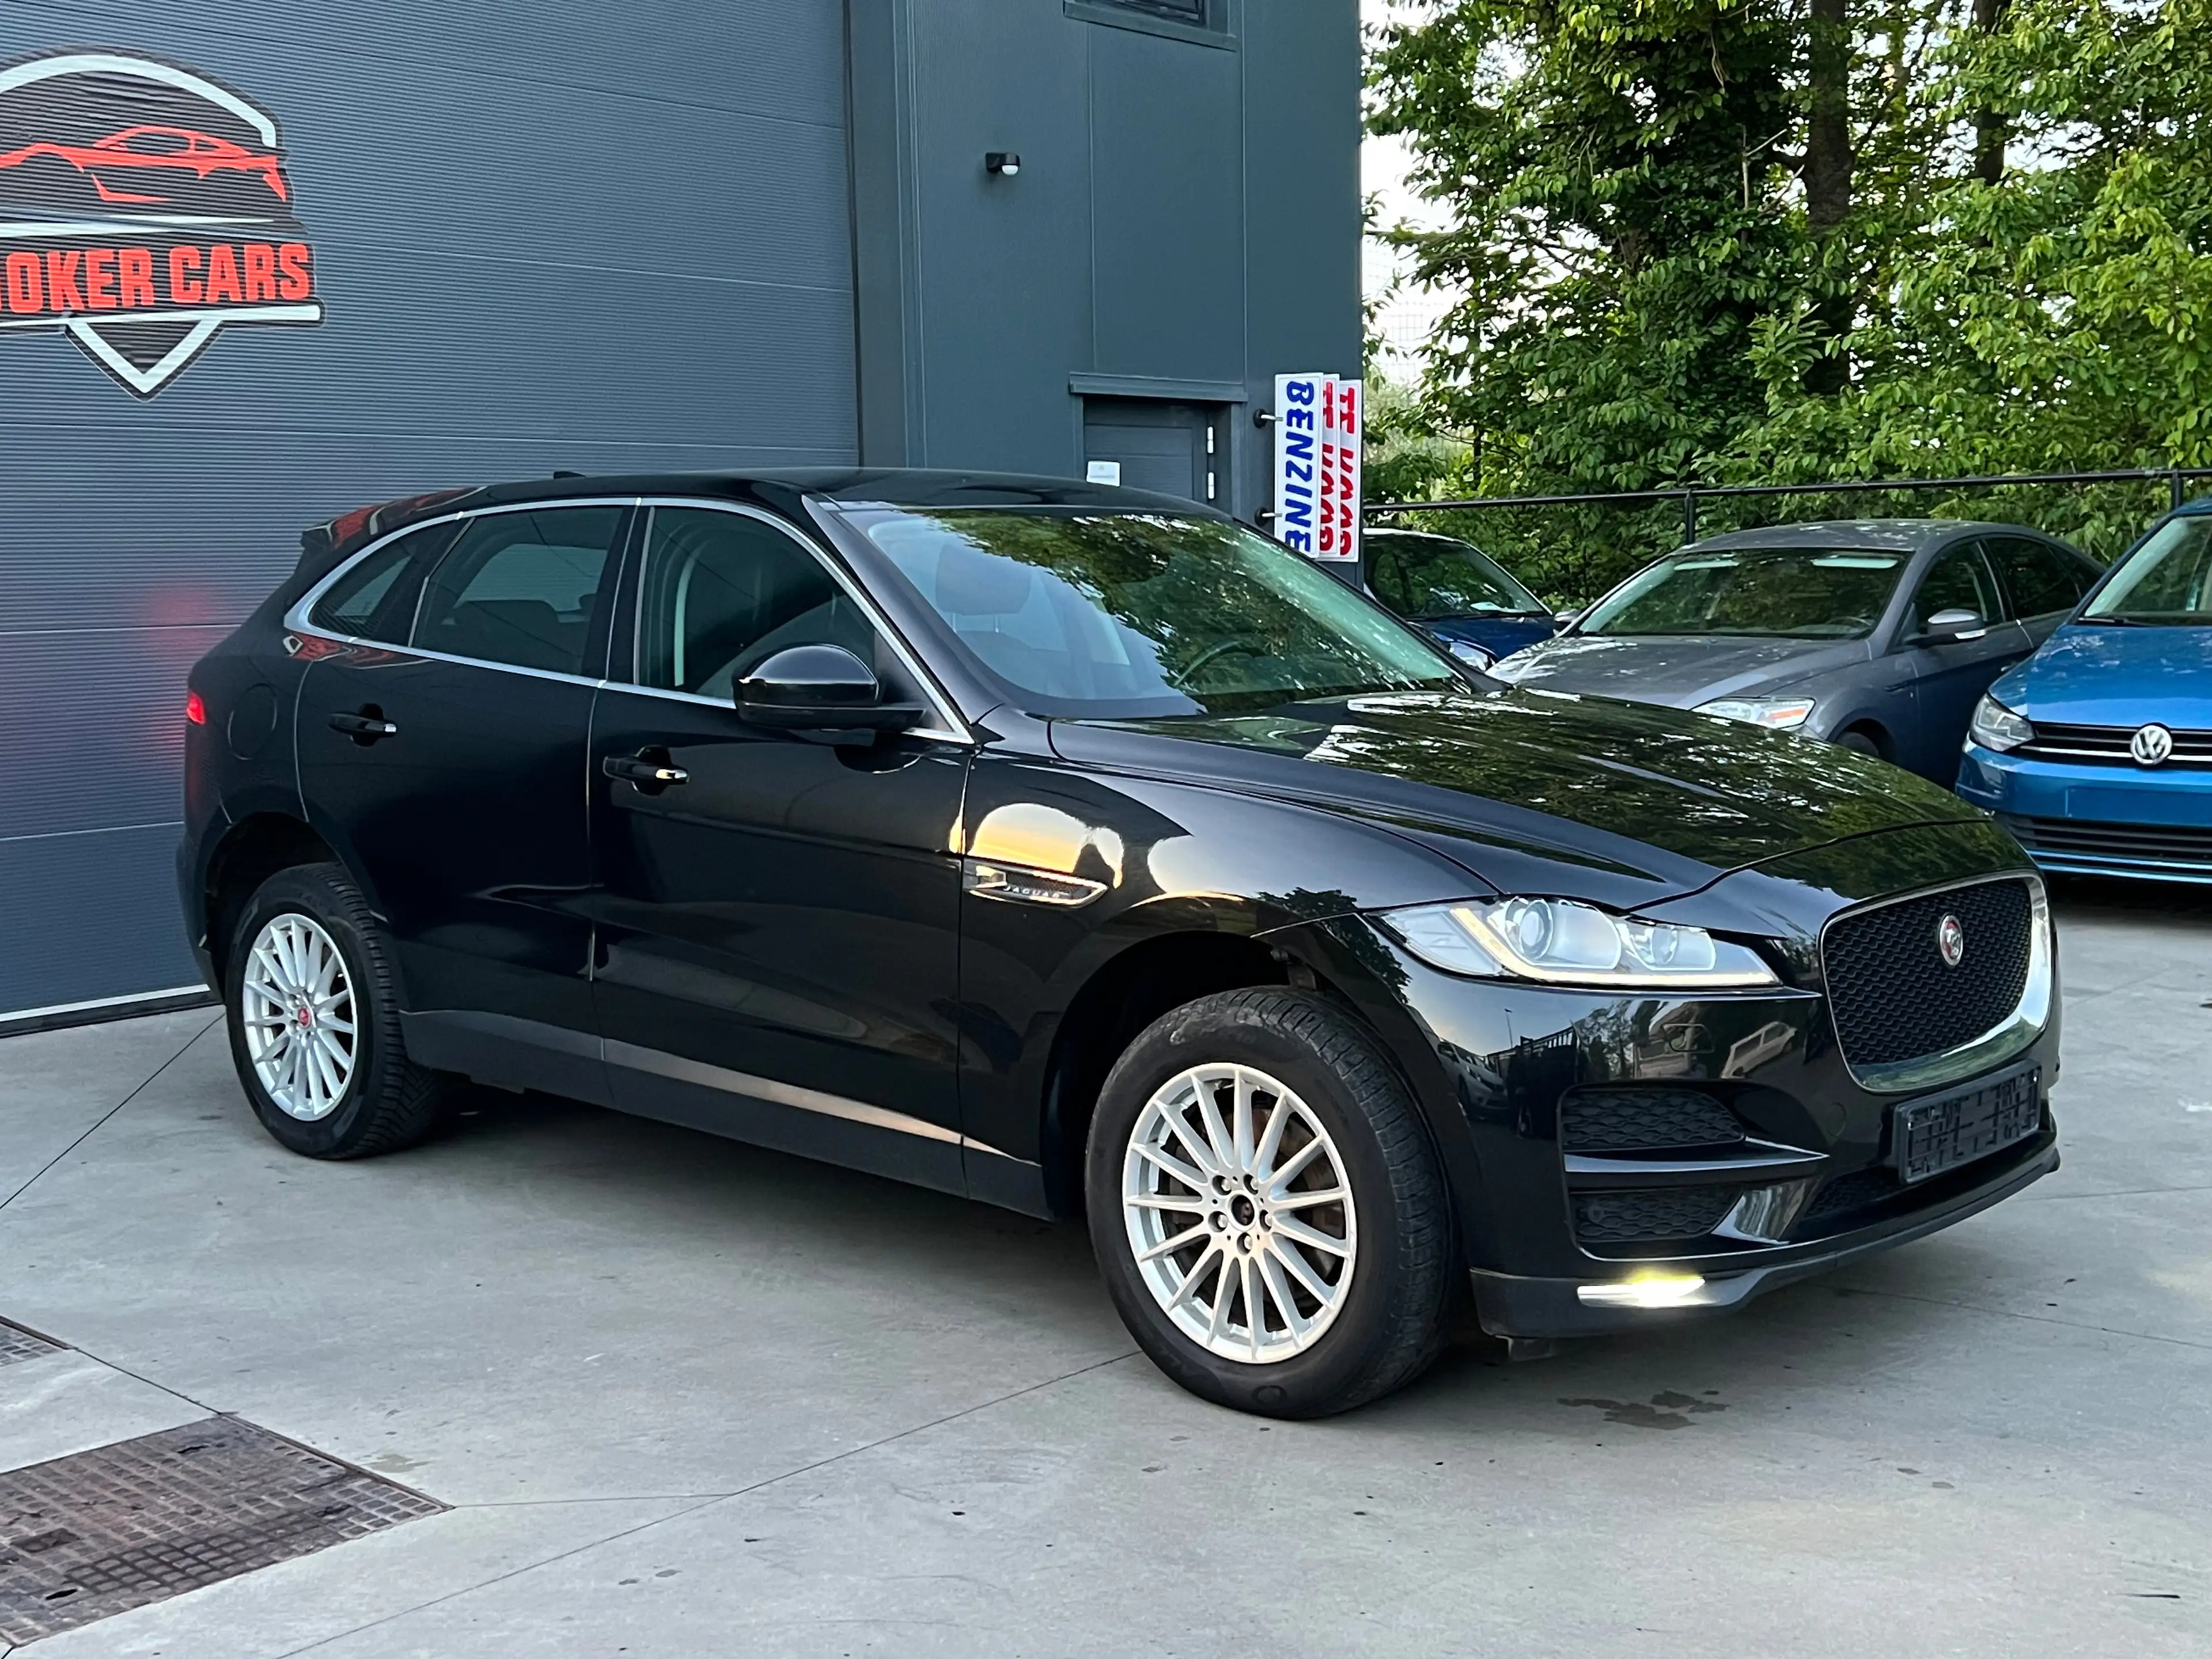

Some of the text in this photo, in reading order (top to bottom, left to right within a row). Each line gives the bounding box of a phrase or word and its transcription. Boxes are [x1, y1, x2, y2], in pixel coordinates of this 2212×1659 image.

[0, 242, 309, 313] OKER CARS
[1285, 381, 1314, 552] BENZINE
